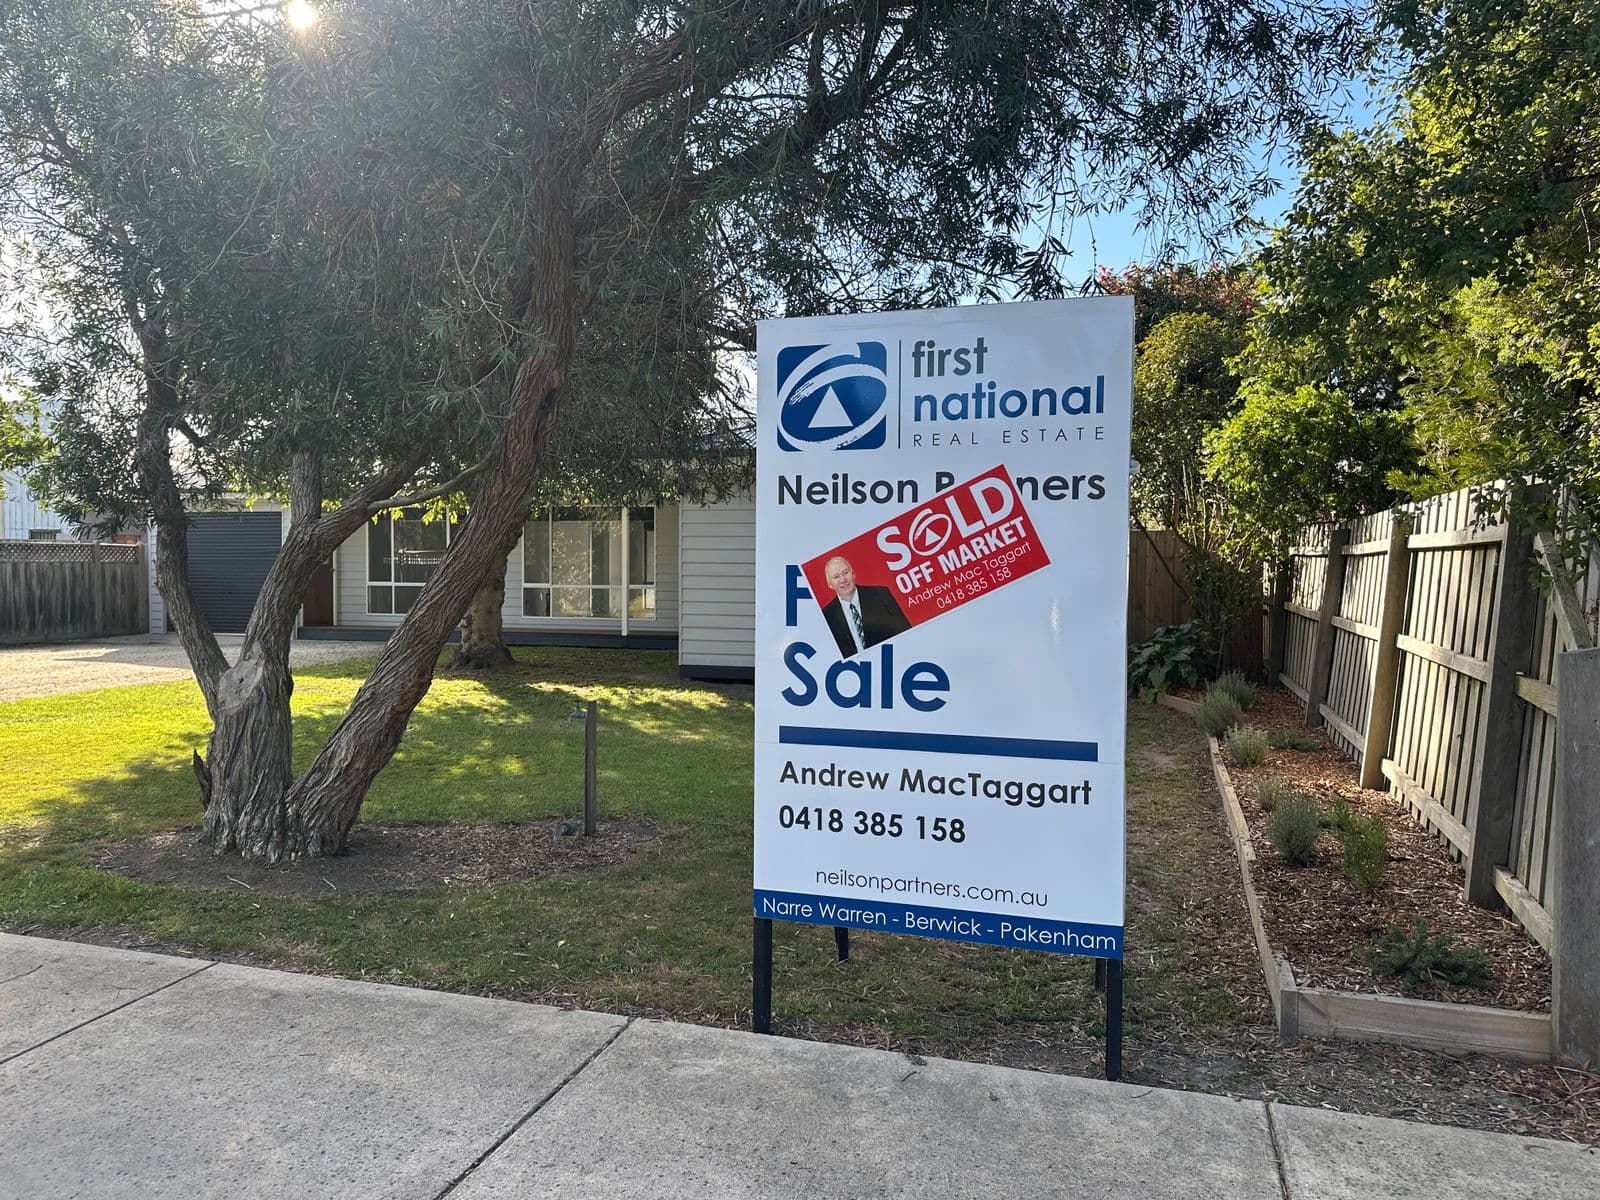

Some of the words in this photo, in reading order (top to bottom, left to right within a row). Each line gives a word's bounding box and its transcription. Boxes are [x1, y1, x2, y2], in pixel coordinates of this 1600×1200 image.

[912, 337, 988, 378] first
[913, 375, 1105, 422] national
[913, 432, 978, 447] REAL
[1002, 426, 1105, 444] ESTATE
[777, 472, 918, 505] Neilson
[935, 471, 1106, 503] Pners
[895, 561, 934, 594] OFF
[937, 516, 1028, 575] MARKET
[907, 580, 951, 608] Andrew
[954, 565, 982, 585] Mac
[981, 541, 1032, 572] Taggart
[936, 588, 965, 609] 0418
[965, 578, 988, 596] 385
[990, 567, 1012, 585] 158
[781, 641, 951, 712] Sale
[779, 761, 889, 790] Andrew
[900, 768, 1092, 808] MacTaggart
[779, 805, 844, 833] 0418
[853, 810, 904, 838] 385
[915, 815, 966, 843] 158
[816, 869, 1049, 907] neilsonpartners.com.au
[763, 896, 813, 918] Narre
[818, 902, 887, 926] Warren
[905, 912, 981, 937] Berwick
[1000, 922, 1116, 951] Pakenham
